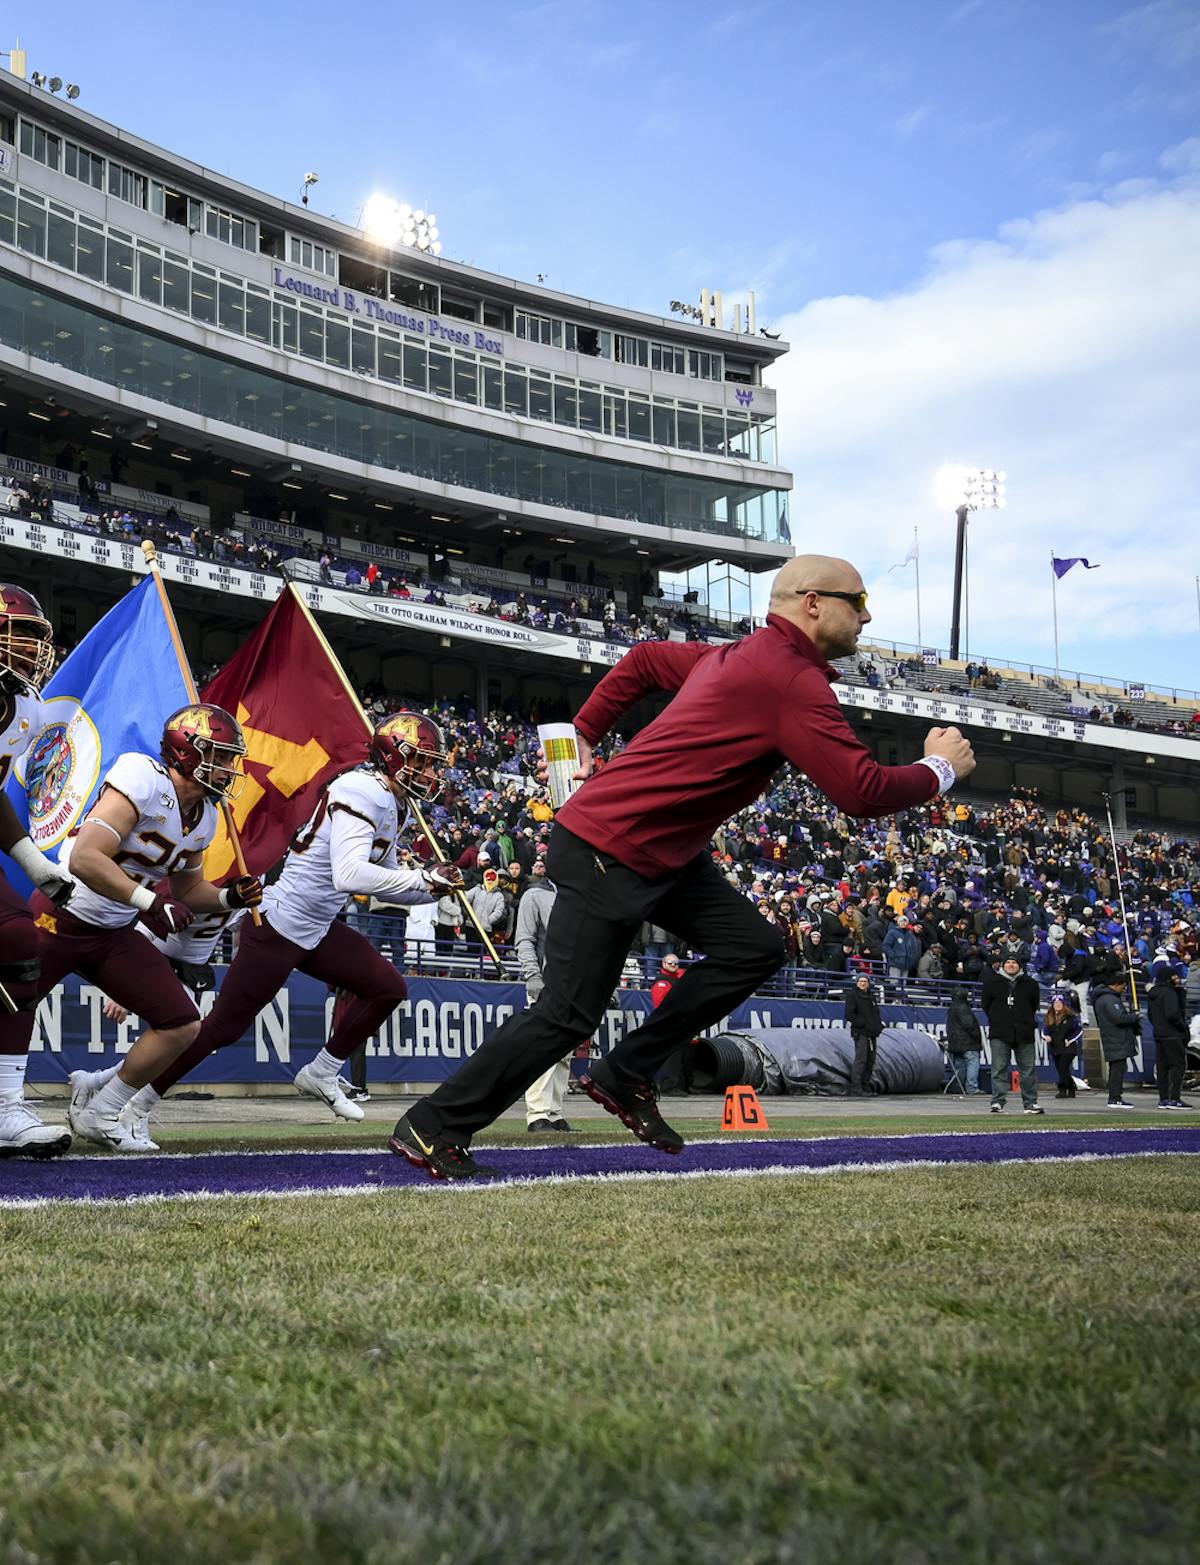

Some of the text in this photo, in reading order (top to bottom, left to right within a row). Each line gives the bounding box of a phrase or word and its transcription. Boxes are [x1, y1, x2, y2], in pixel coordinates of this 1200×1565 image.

[274, 267, 502, 354] Leonard B. Thomas Press Box
[6, 456, 69, 483] WILDCAT DEN
[25, 531, 46, 544] MORRIS
[251, 517, 304, 540] WILDCAT DEN
[57, 538, 80, 550] GRAHAM
[360, 543, 410, 562] WILDCAT DEN
[373, 603, 532, 642] THE OTTO GRAHAM WILDCAT HONOR ROLL
[923, 655, 937, 665] 232
[1130, 690, 1144, 698] 233
[255, 987, 290, 1063] N
[739, 1093, 758, 1124] G
